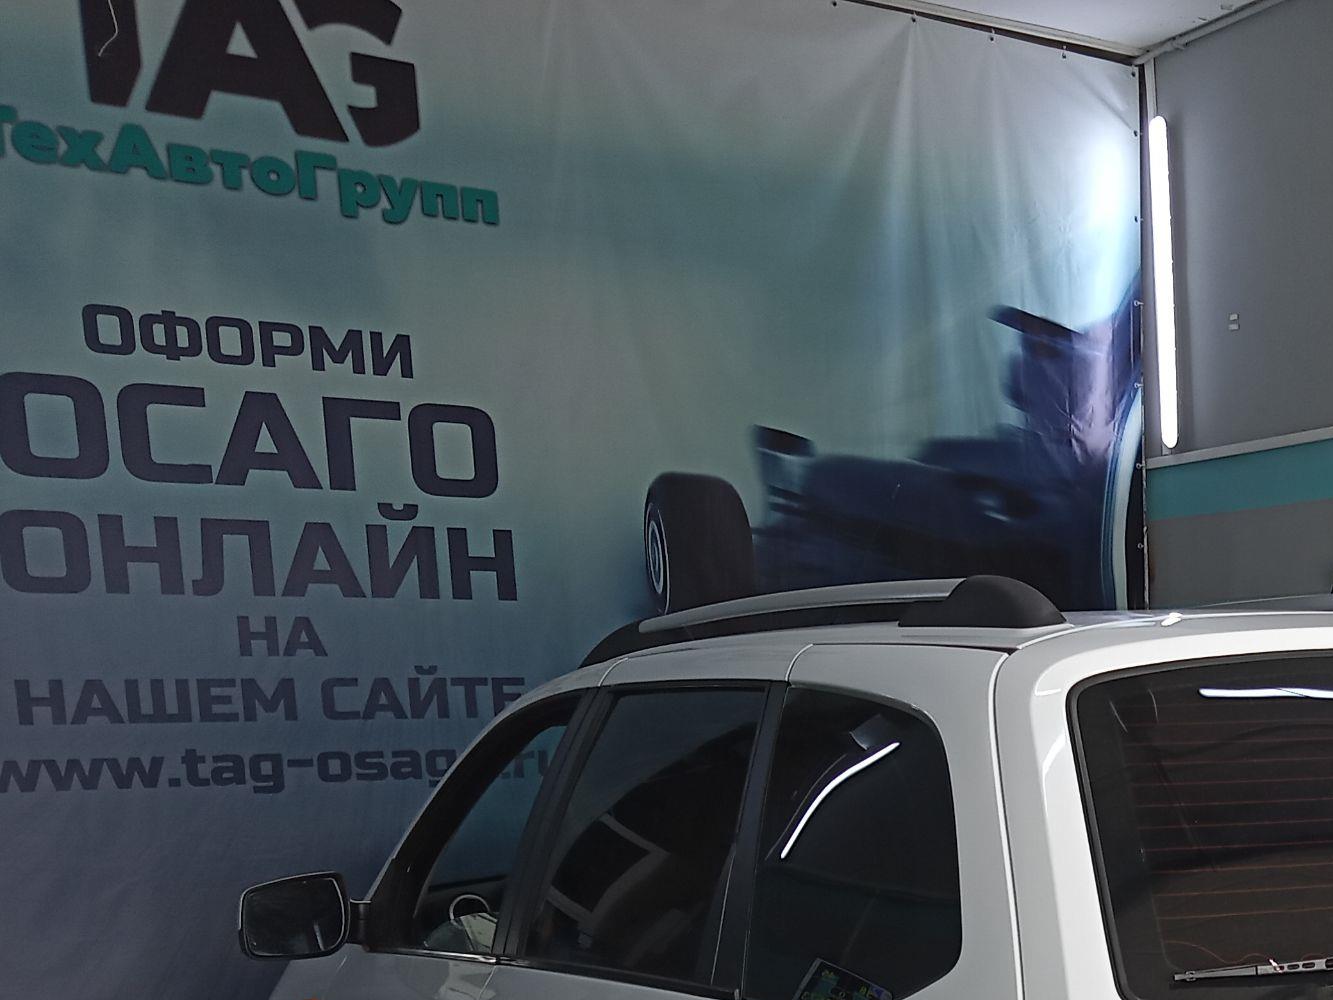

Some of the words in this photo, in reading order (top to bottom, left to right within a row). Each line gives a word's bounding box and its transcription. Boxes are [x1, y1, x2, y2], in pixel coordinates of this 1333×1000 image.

[81, 303, 414, 379] ОФОРМИ
[0, 371, 500, 498] ОСАГО
[0, 503, 518, 602] ОНЛАЙН
[236, 615, 328, 657] НА
[14, 678, 299, 726] НАШЕМ
